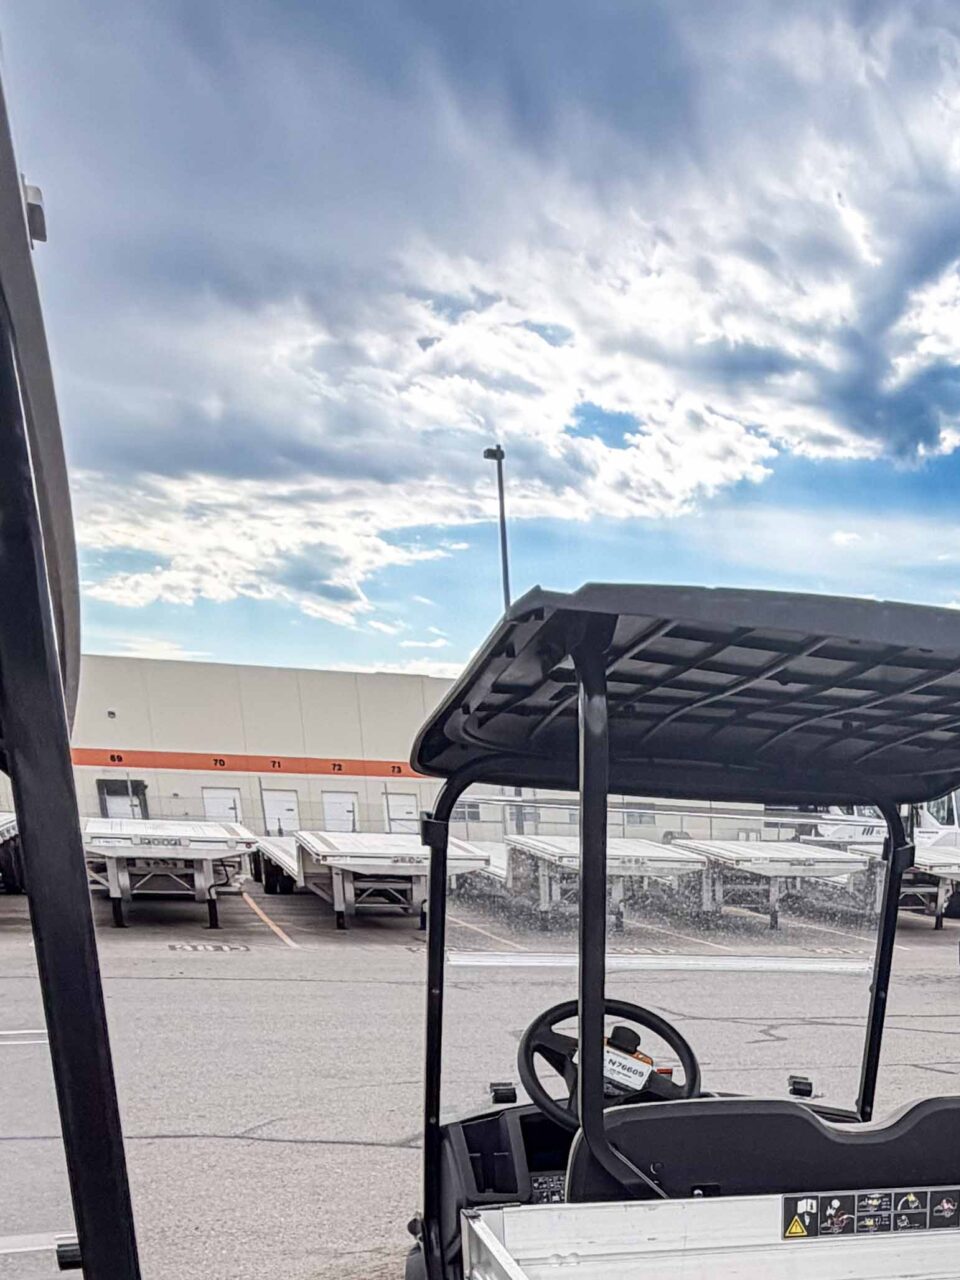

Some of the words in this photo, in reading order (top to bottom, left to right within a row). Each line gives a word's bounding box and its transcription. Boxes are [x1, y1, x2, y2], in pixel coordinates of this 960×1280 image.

[213, 758, 226, 767] 70
[270, 760, 281, 769] 71
[331, 763, 343, 772] 72
[391, 765, 402, 774] 73
